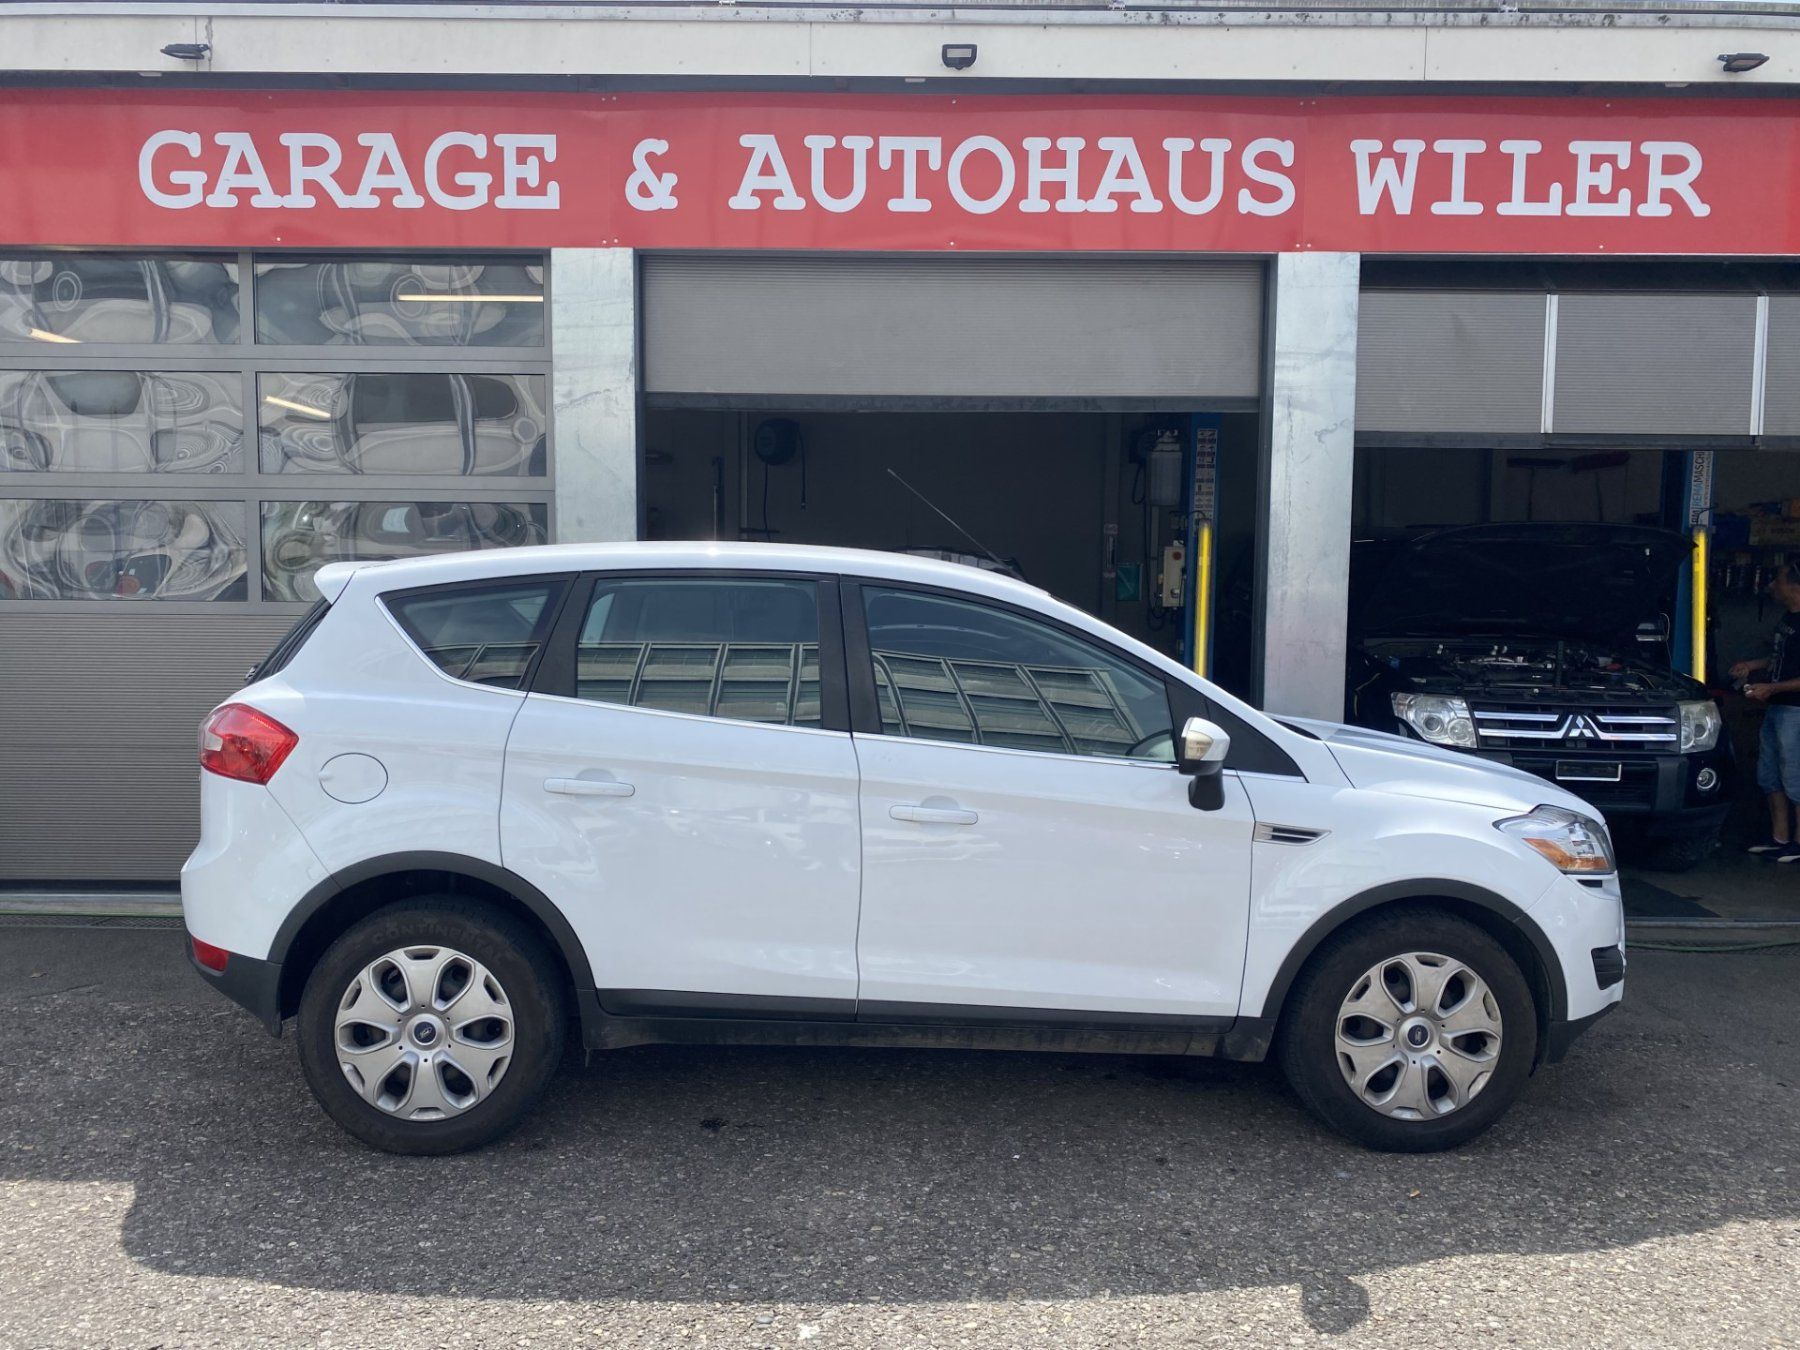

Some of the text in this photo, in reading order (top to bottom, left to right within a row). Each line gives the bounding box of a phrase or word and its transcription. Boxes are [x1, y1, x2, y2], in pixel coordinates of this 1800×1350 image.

[139, 130, 1710, 216] GARAGE & AUTOHAUS WILER
